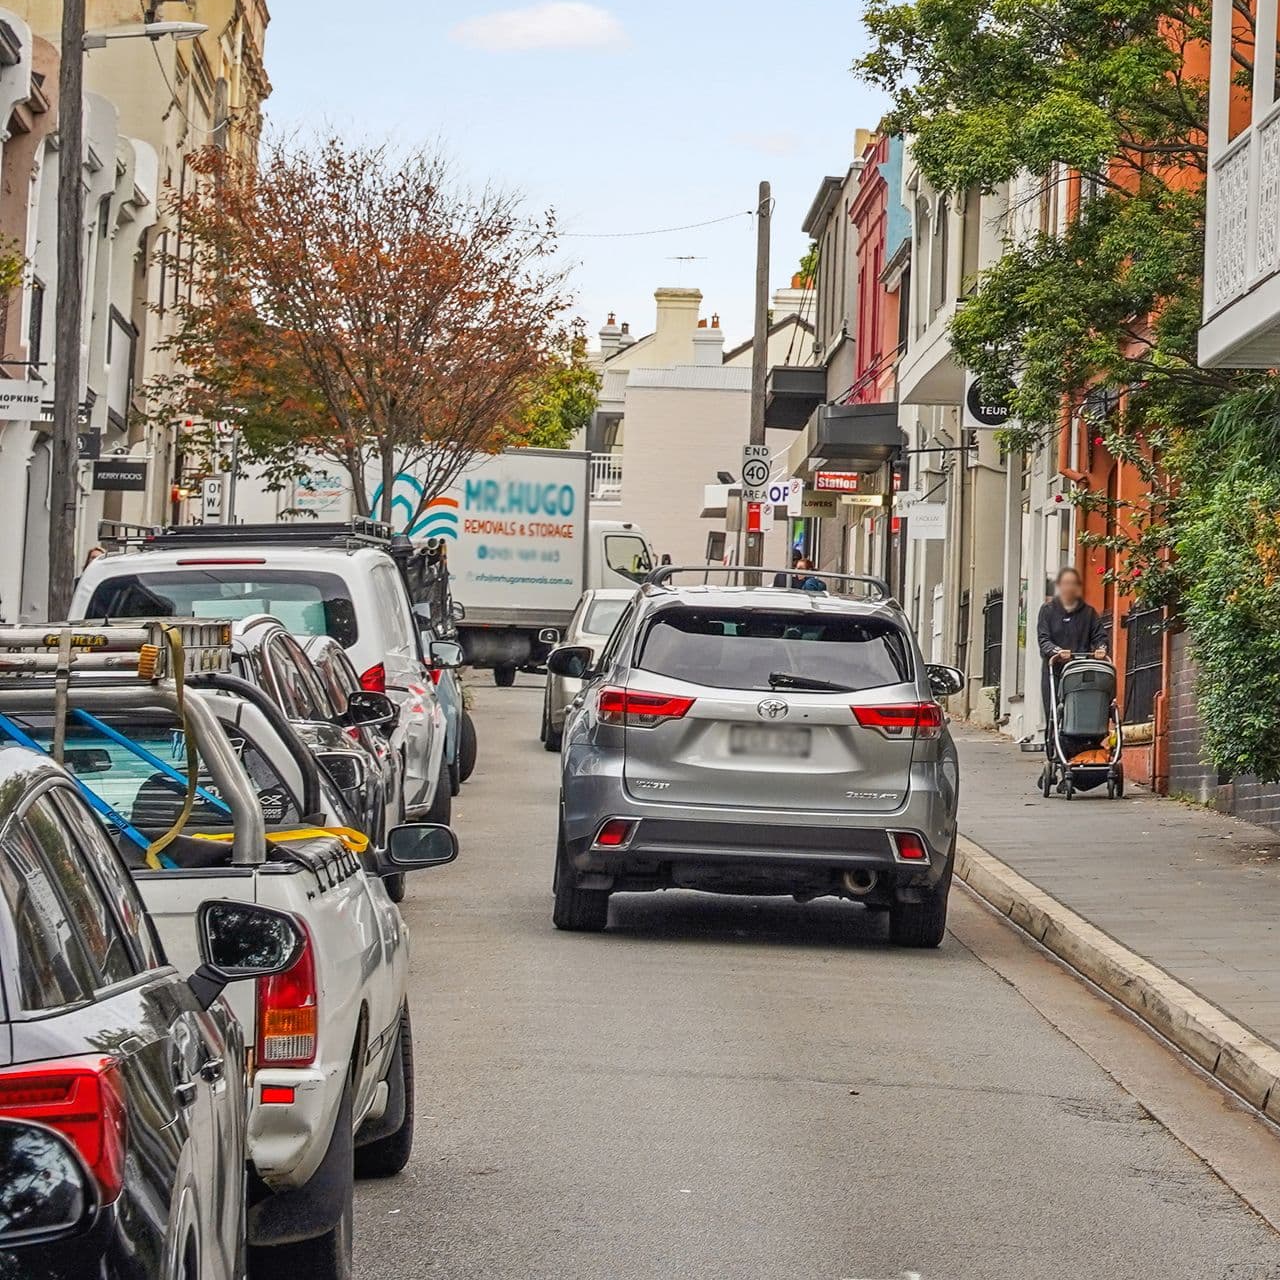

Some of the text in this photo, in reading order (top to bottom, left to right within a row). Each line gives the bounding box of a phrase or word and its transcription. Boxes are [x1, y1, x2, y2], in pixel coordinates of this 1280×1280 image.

[980, 406, 1007, 415] TEUR
[744, 447, 769, 456] END
[745, 466, 766, 481] 40
[818, 477, 857, 489] Station
[743, 490, 767, 499] AREA
[464, 519, 574, 538] REMOVALS & STORAGE
